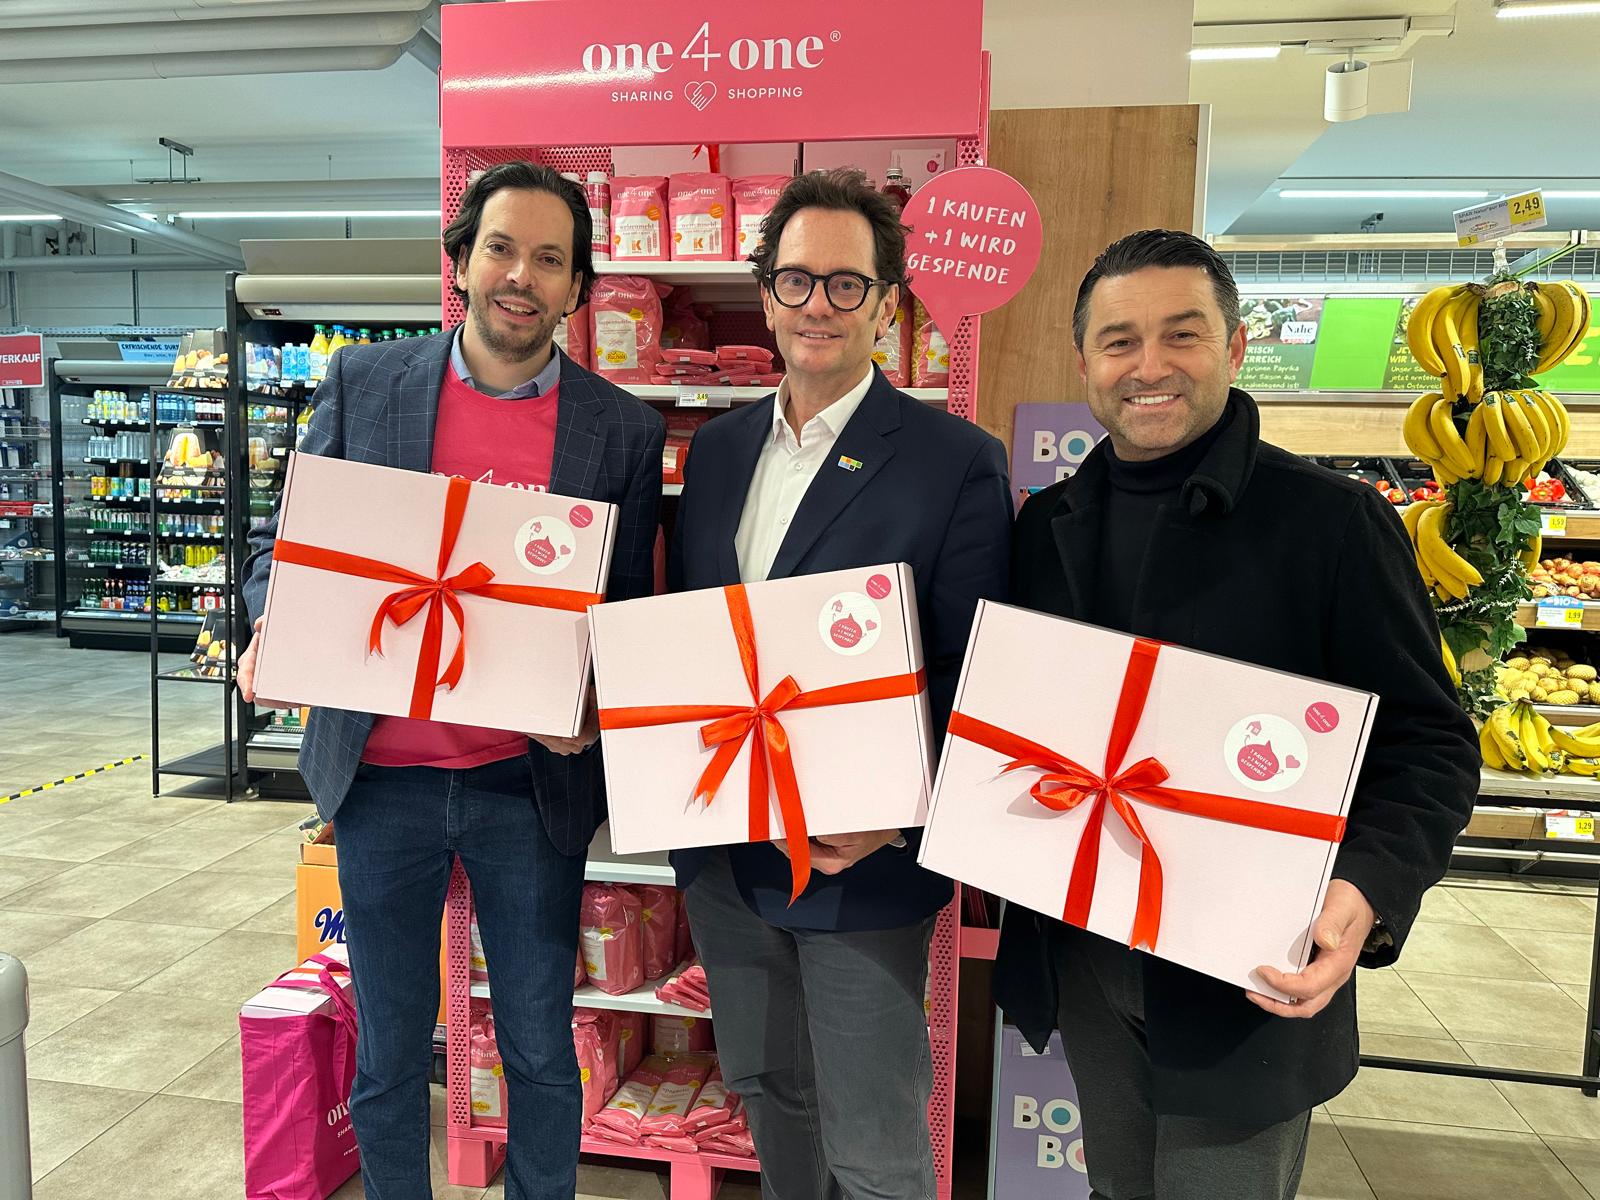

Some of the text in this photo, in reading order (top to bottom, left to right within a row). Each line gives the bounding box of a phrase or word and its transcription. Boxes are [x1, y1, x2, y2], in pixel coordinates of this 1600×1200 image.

[611, 86, 803, 103] SHARING SHOPPING
[927, 196, 1026, 228] 1 KAUFEN
[1513, 196, 1540, 215] 2,49
[960, 231, 1016, 256] WIRD
[907, 252, 1010, 284] GESPENDE
[1578, 821, 1592, 831] 1,29
[1013, 1094, 1081, 1134] BO
